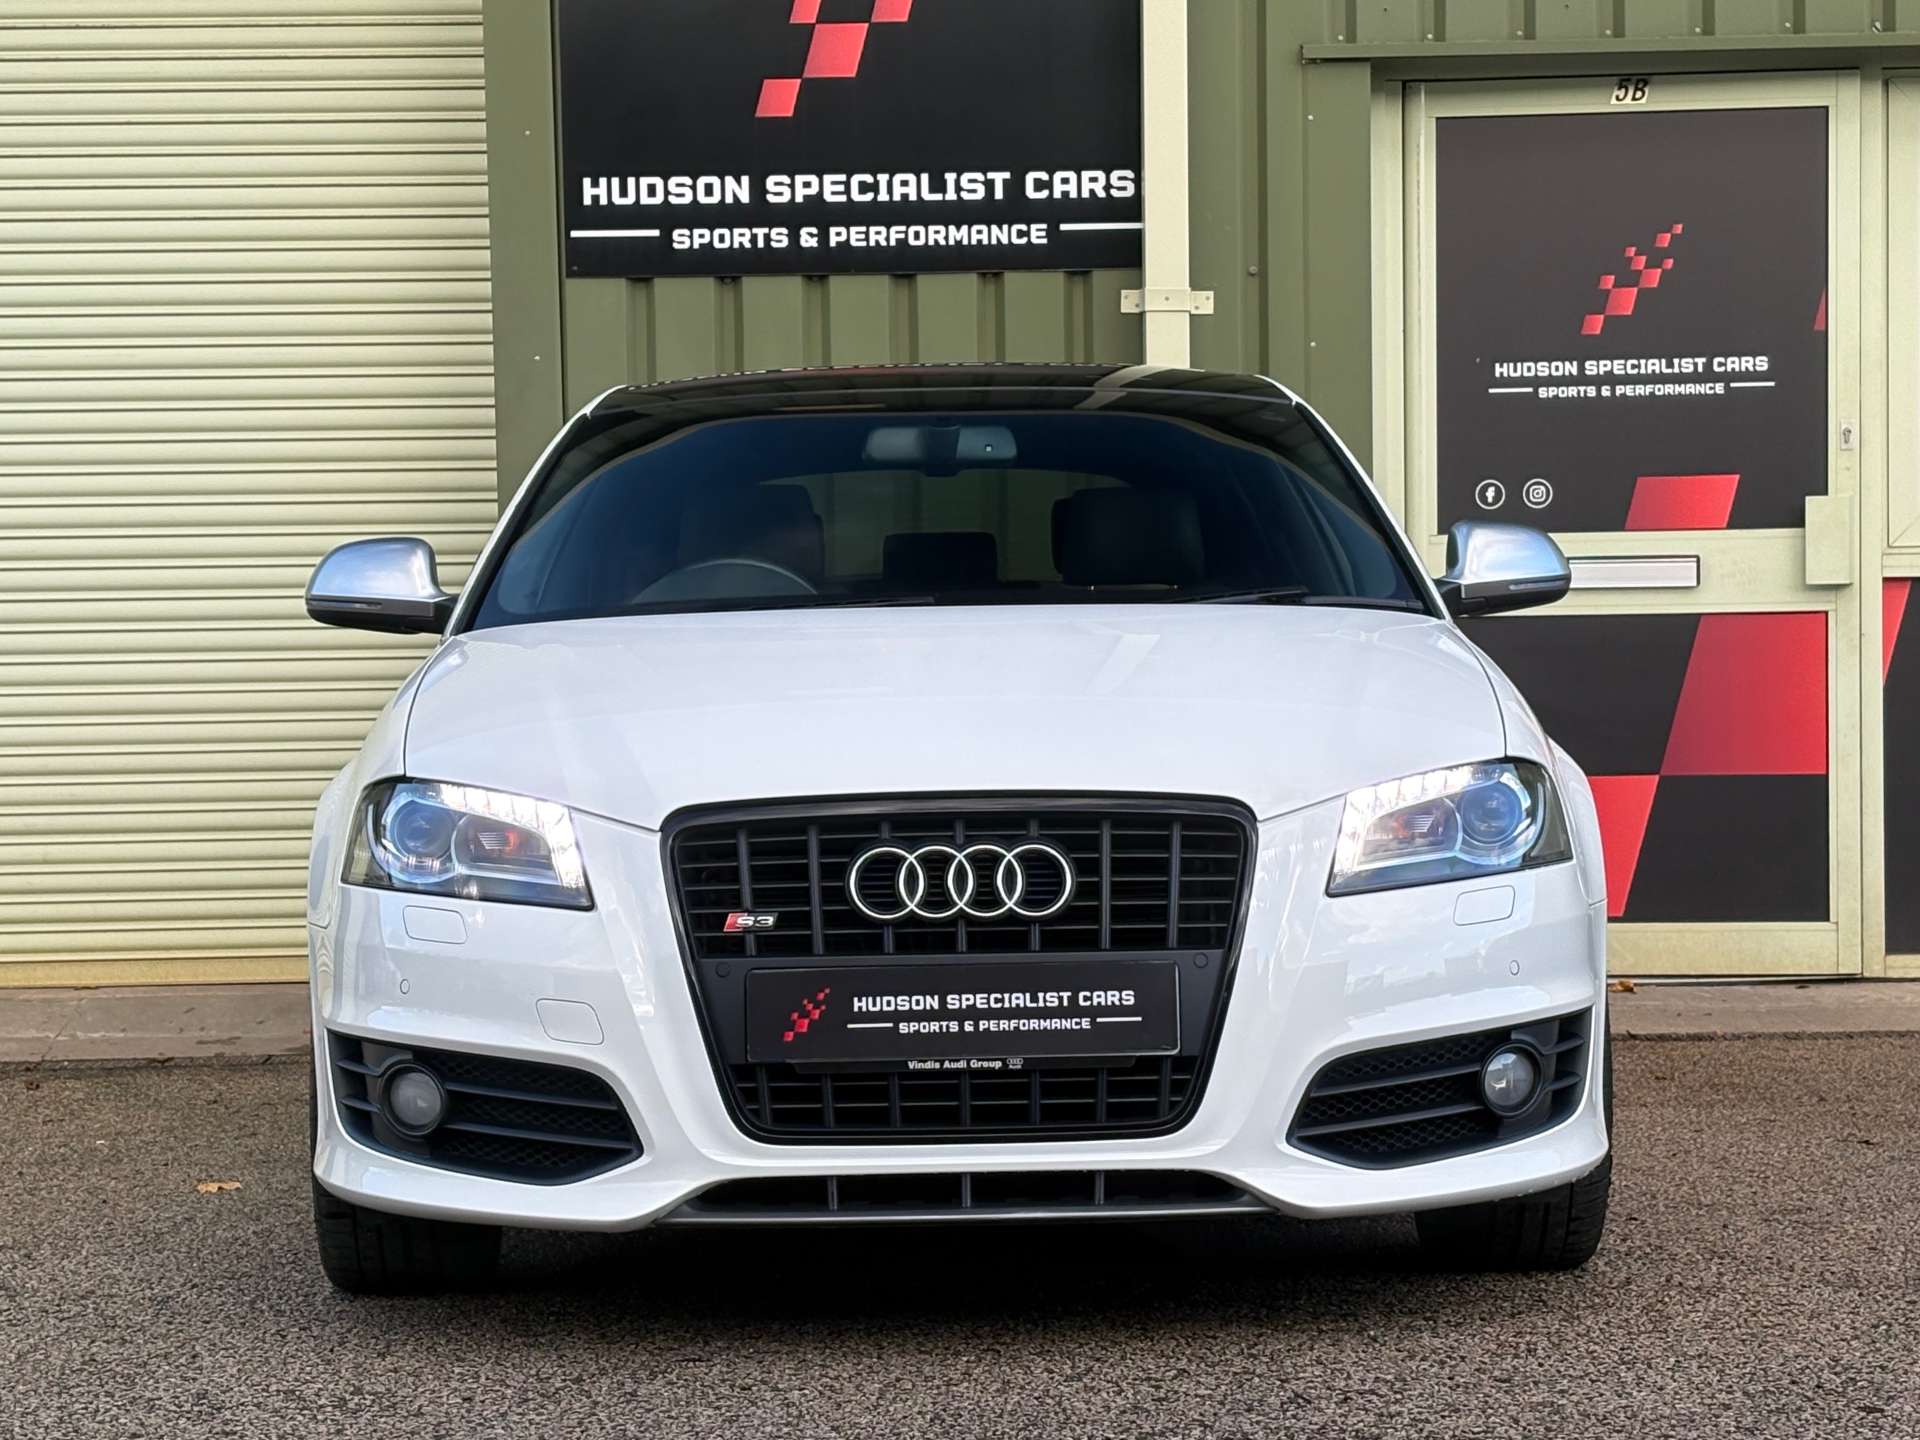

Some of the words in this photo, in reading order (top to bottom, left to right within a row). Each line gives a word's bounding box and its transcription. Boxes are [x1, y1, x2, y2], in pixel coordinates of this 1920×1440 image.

[1615, 78, 1649, 102] 5B
[582, 175, 750, 206] HUDSON
[765, 171, 1011, 204] SPECIALIST
[1025, 169, 1136, 200] CARS
[671, 227, 789, 250] SPORTS
[799, 226, 819, 248] &
[829, 223, 1048, 247] PERFORMANCE
[1494, 360, 1578, 378] HUDSON
[1584, 357, 1707, 376] SPECIALIST
[1712, 355, 1769, 373] CARS
[1537, 385, 1597, 399] SPORTS
[1600, 385, 1612, 398] &
[1615, 382, 1725, 397] PERFORMANCE
[853, 994, 939, 1013] HUDSON
[946, 991, 1072, 1010] SPECIALIST
[1078, 990, 1136, 1007] CARS
[898, 1020, 959, 1034] SPORTS
[963, 1020, 975, 1032] &
[978, 1017, 1092, 1032] PERFORMANCE
[907, 1060, 941, 1070] Vindis
[943, 1059, 967, 1069] Audi
[969, 1059, 1003, 1070] Group
